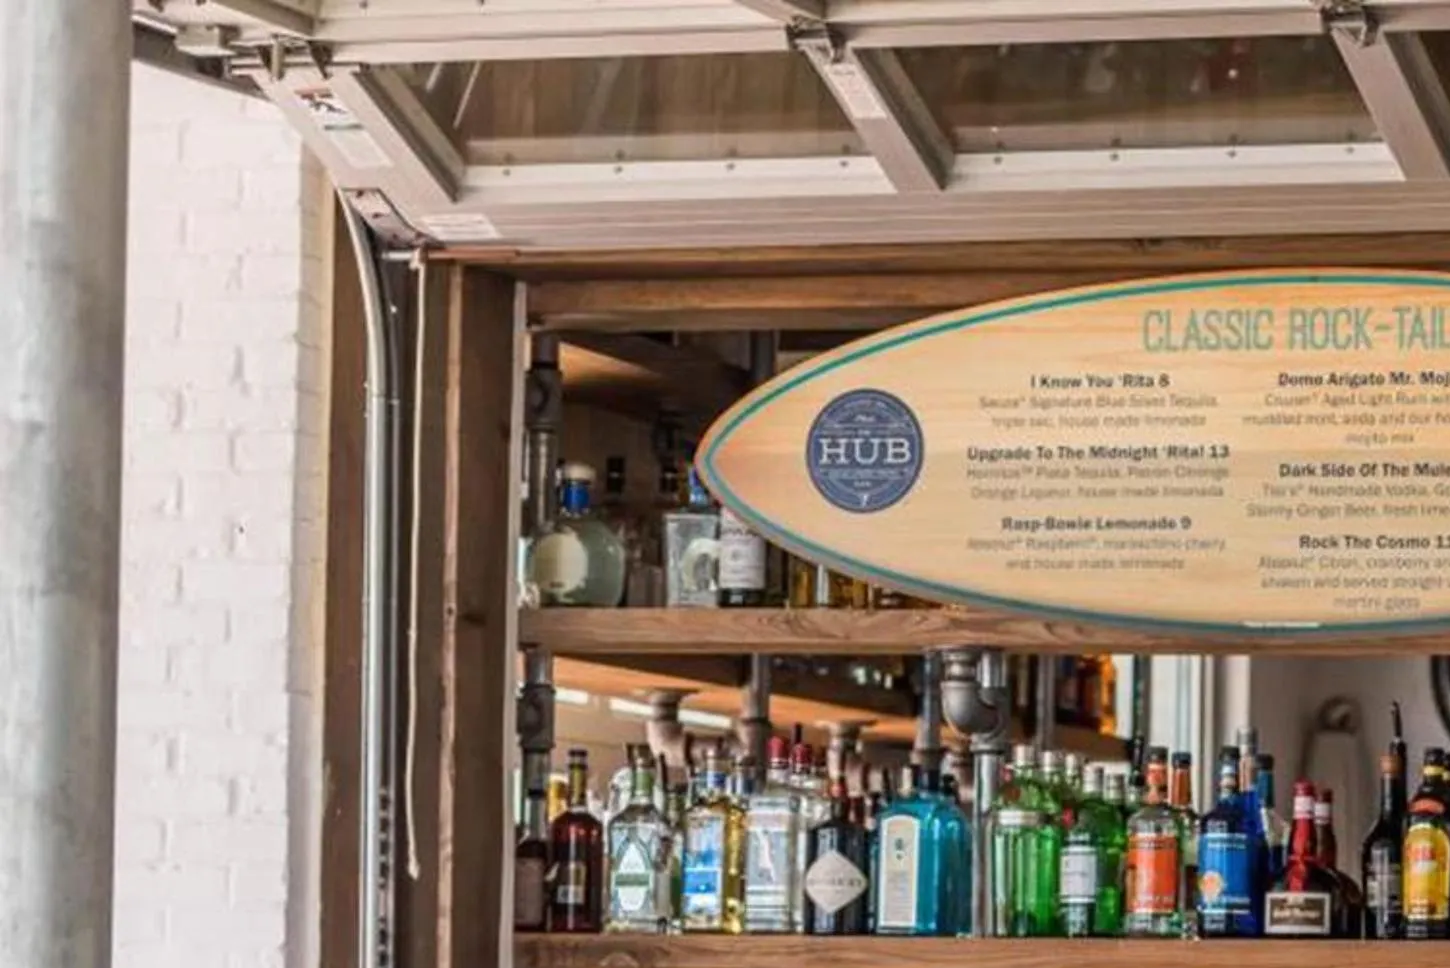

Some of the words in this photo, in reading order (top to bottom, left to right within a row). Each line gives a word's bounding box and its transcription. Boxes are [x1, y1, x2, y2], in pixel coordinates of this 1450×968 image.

[1142, 307, 1275, 351] CLASSIC
[1040, 374, 1081, 388] Know
[1087, 374, 1112, 388] You
[1278, 372, 1323, 387] Domo
[1327, 372, 1385, 387] Arigato
[1390, 372, 1414, 387] Mr.
[819, 438, 911, 464] HUB
[968, 446, 1031, 461] Upgrade
[1037, 446, 1052, 461] To
[1058, 446, 1084, 461] The
[1089, 446, 1157, 461] Midnight
[1210, 446, 1229, 461] 13
[1279, 464, 1315, 477] Dark
[1322, 464, 1354, 477] Side
[1359, 464, 1377, 477] Of
[1382, 464, 1408, 477] The
[1097, 516, 1177, 531] Lemonade
[1181, 516, 1191, 531] 9
[1300, 536, 1338, 549] Rock
[1344, 536, 1371, 549] The
[1376, 536, 1430, 549] Cosmo
